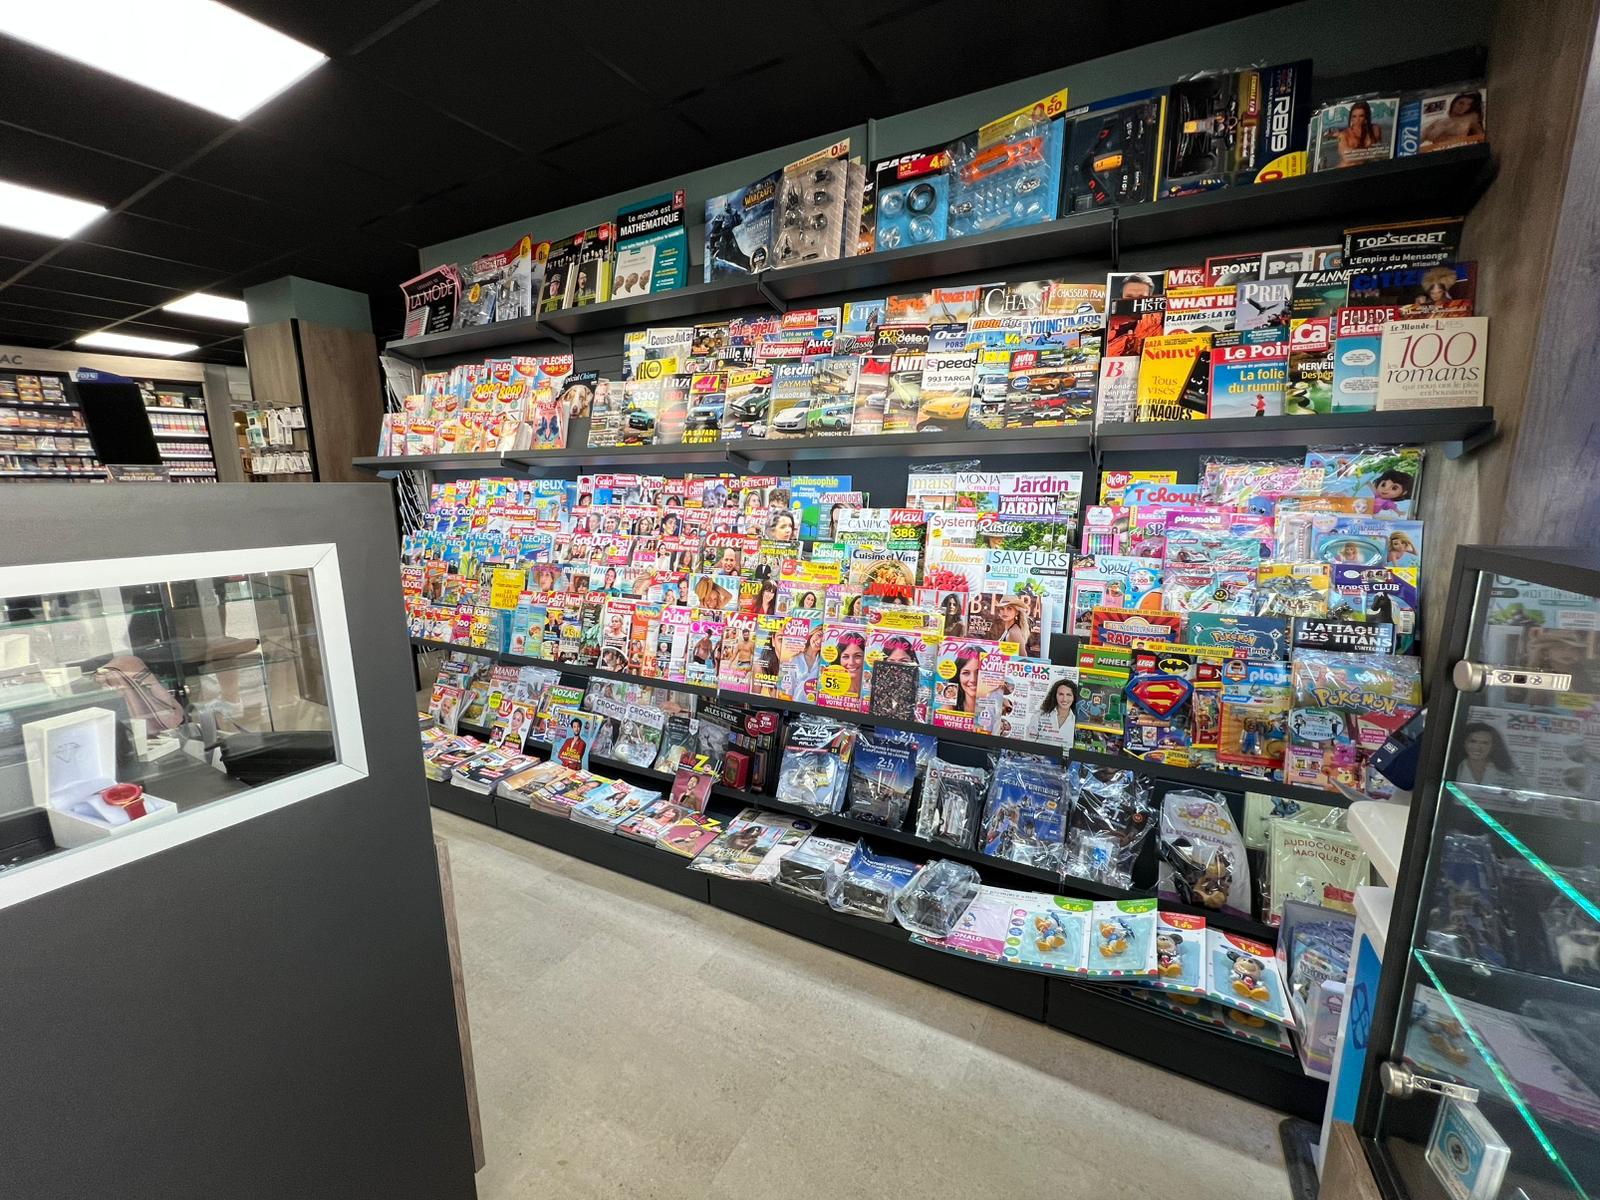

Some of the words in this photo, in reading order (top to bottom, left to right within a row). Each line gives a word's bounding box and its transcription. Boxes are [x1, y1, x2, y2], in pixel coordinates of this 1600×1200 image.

[620, 211, 680, 237] MATHÉMATIQUE
[1169, 297, 1213, 311] WHAT
[1225, 347, 1246, 361] Le
[1401, 331, 1477, 369] 100
[1240, 371, 1254, 381] La
[1257, 369, 1285, 380] folie
[1387, 366, 1480, 384] romans
[1229, 383, 1244, 394] du
[1013, 475, 1069, 493] Jardin
[999, 502, 1057, 516] JARDIN
[852, 549, 886, 561] Cuisine
[895, 551, 917, 563] Vins
[992, 550, 1068, 567] SAVEURS
[1008, 663, 1051, 675] mieux
[1136, 659, 1155, 668] LEGO
[629, 706, 662, 724] CROCHET
[954, 932, 982, 943] ONALD
